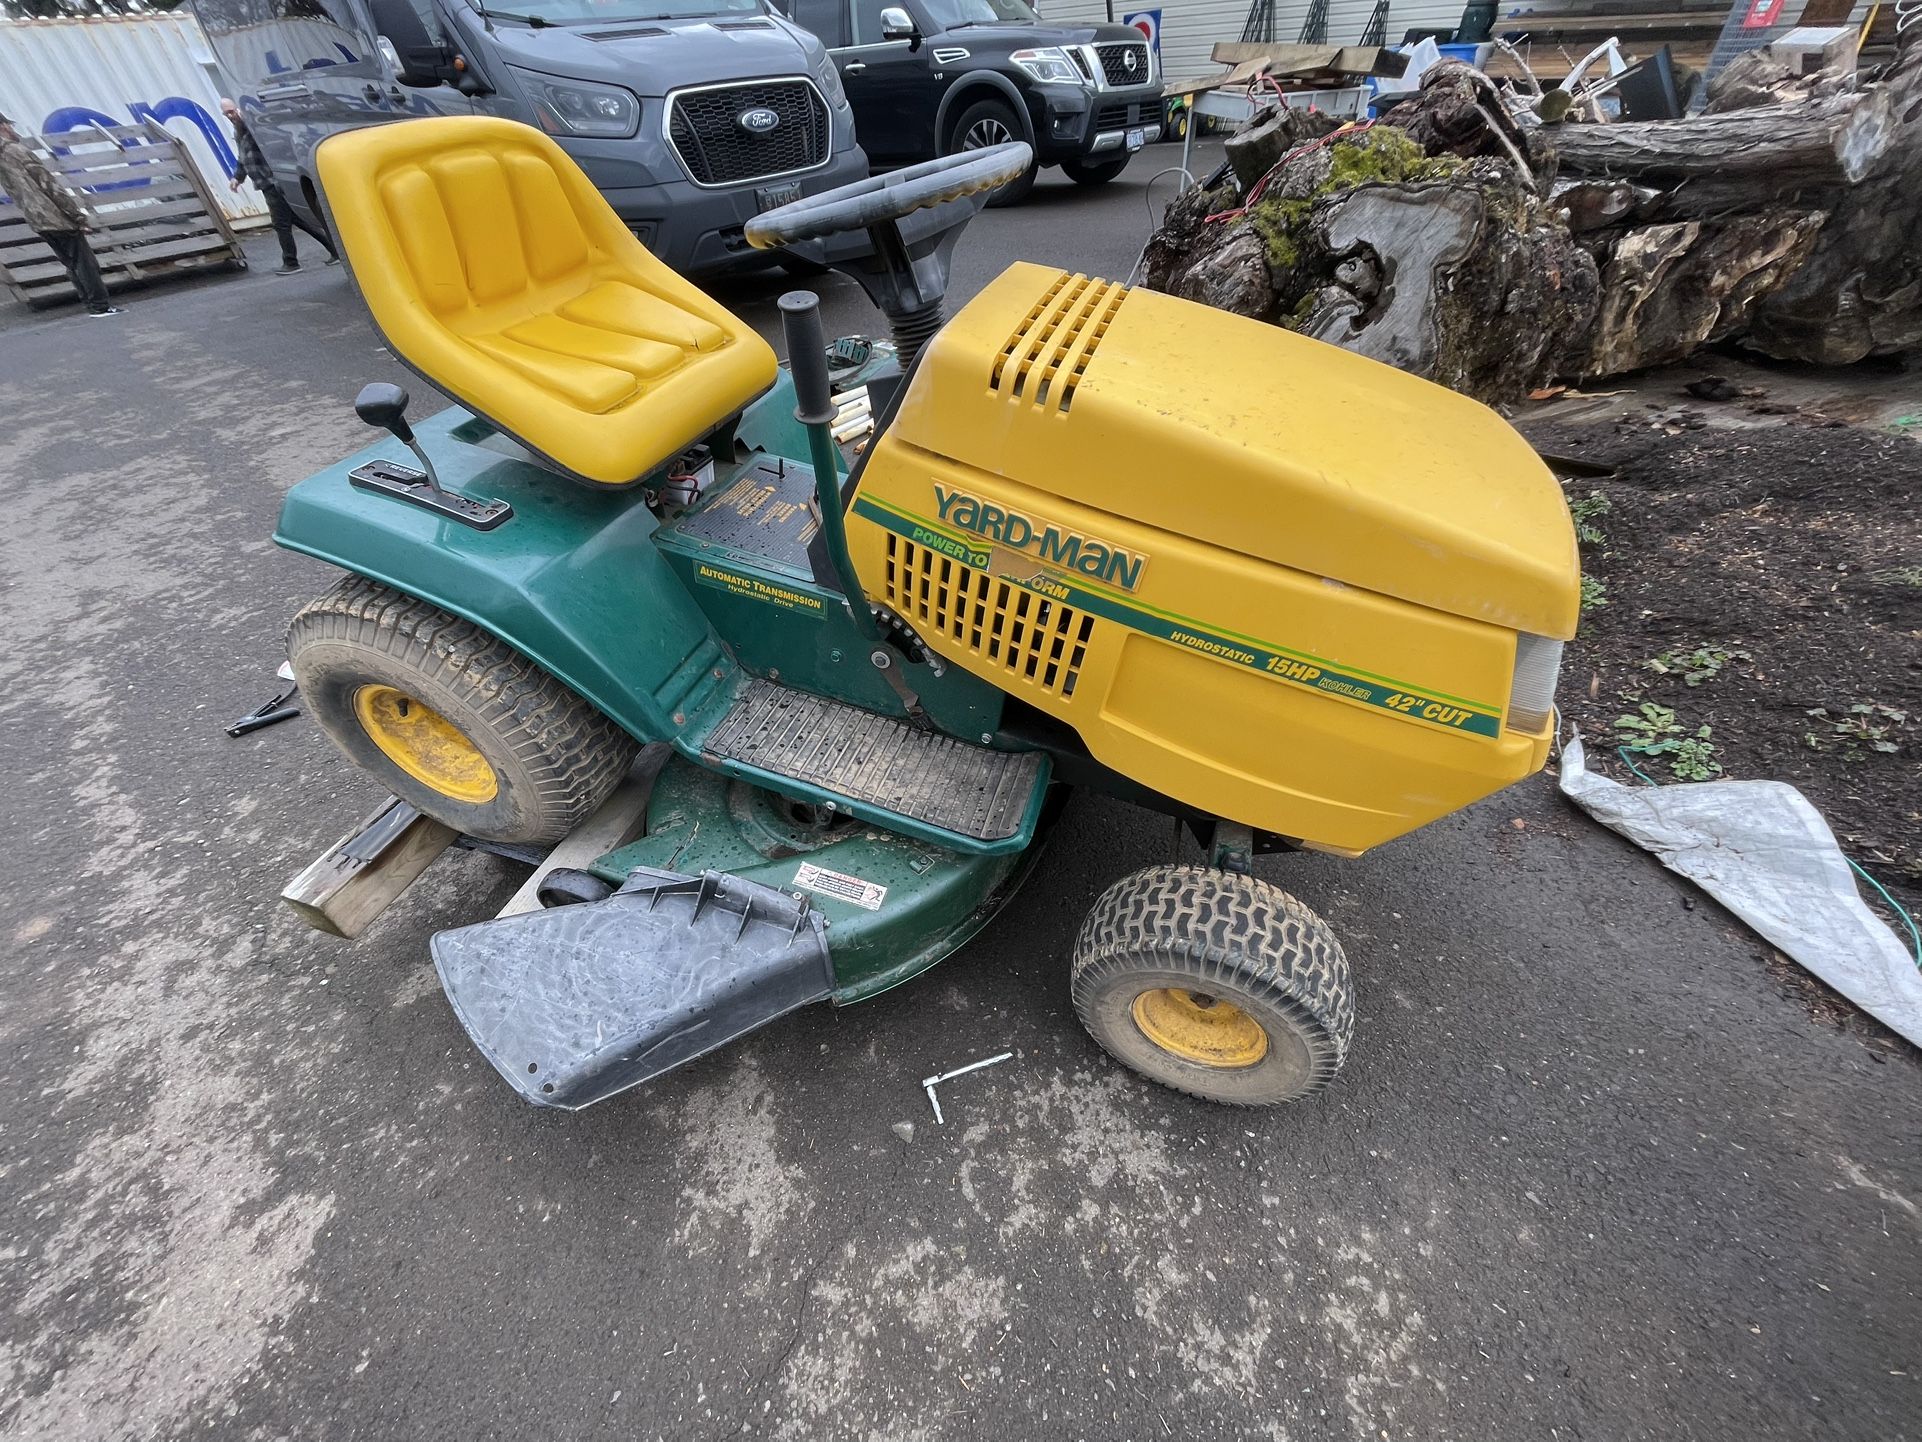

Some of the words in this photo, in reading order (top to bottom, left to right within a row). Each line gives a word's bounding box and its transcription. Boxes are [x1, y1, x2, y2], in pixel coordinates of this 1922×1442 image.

[752, 112, 772, 127] Ford
[912, 527, 965, 559] POWER
[967, 551, 988, 567] TO
[700, 565, 751, 588] AUTOMATIC
[753, 580, 821, 609] TRANSMISSION
[727, 583, 770, 601] Hydrostatic
[773, 597, 794, 608] Drive
[1170, 630, 1255, 664] HYDROSTATIC
[1265, 655, 1321, 682] 15HP
[1317, 676, 1372, 701] KOHLER
[1422, 703, 1473, 726] CUT
